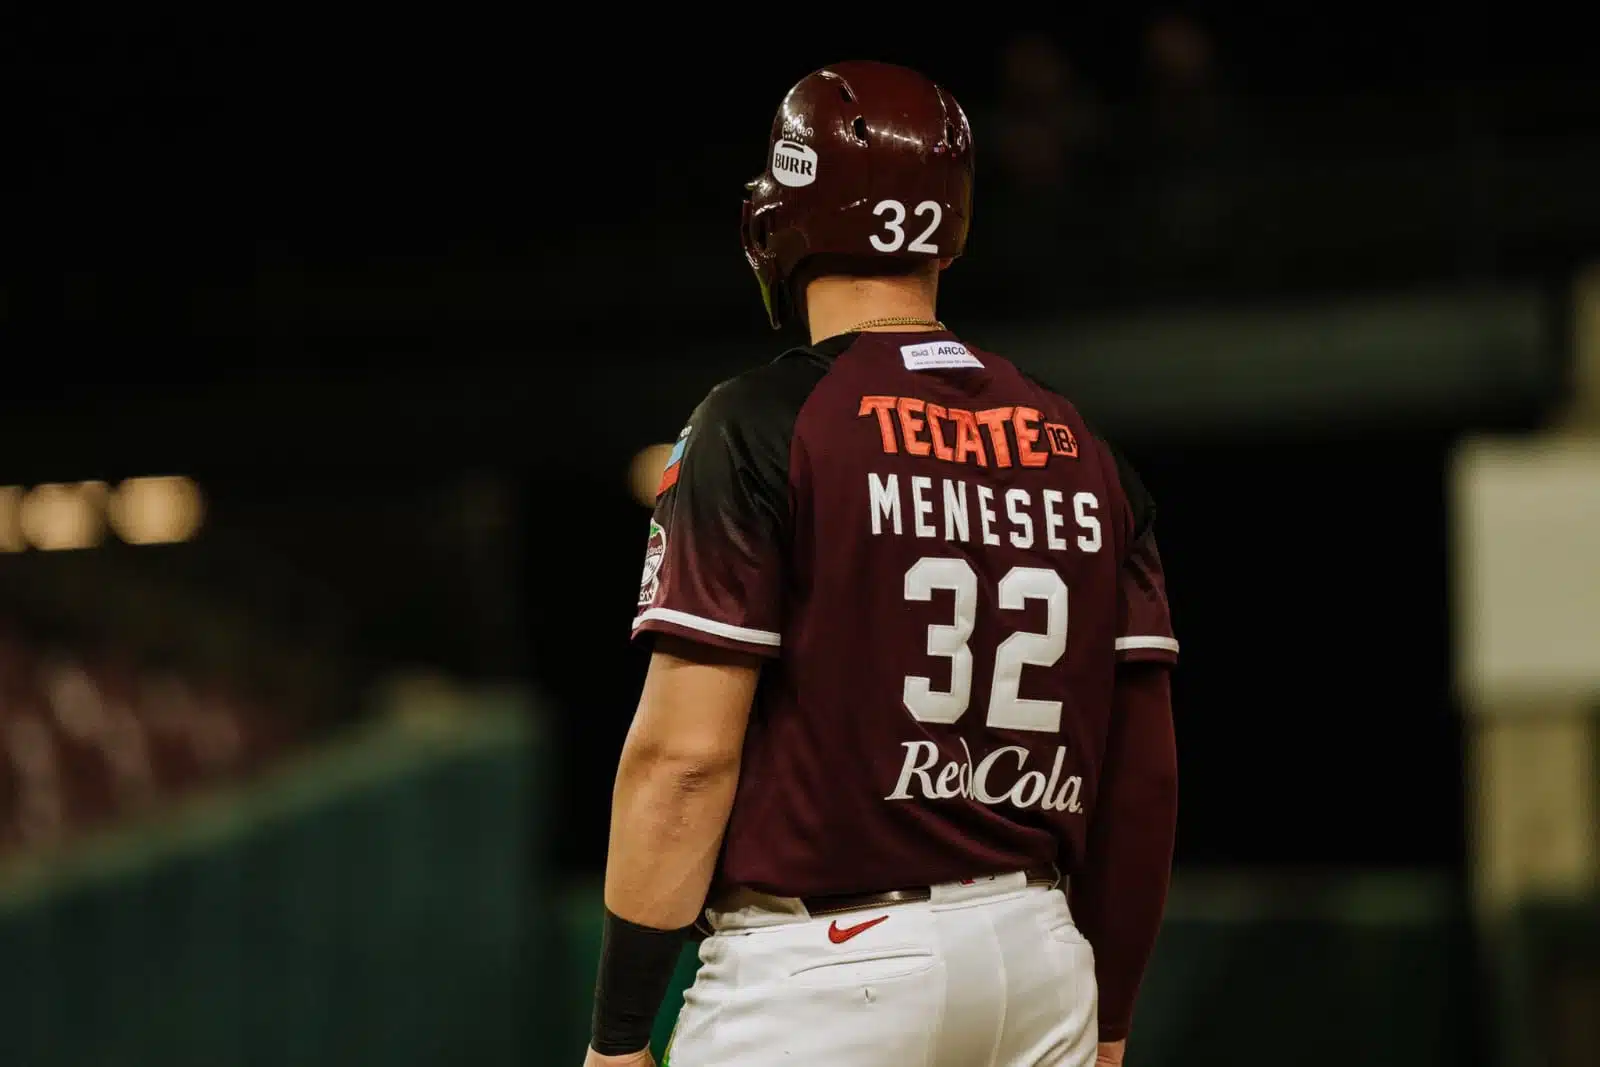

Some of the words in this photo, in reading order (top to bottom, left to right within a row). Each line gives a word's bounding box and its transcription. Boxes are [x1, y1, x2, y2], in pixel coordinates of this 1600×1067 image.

[774, 152, 813, 177] BURR
[869, 199, 943, 254] 32
[858, 395, 1048, 468] TECATE
[1048, 425, 1078, 454] 18+
[868, 472, 1103, 553] MENESES
[903, 556, 1069, 733] 32
